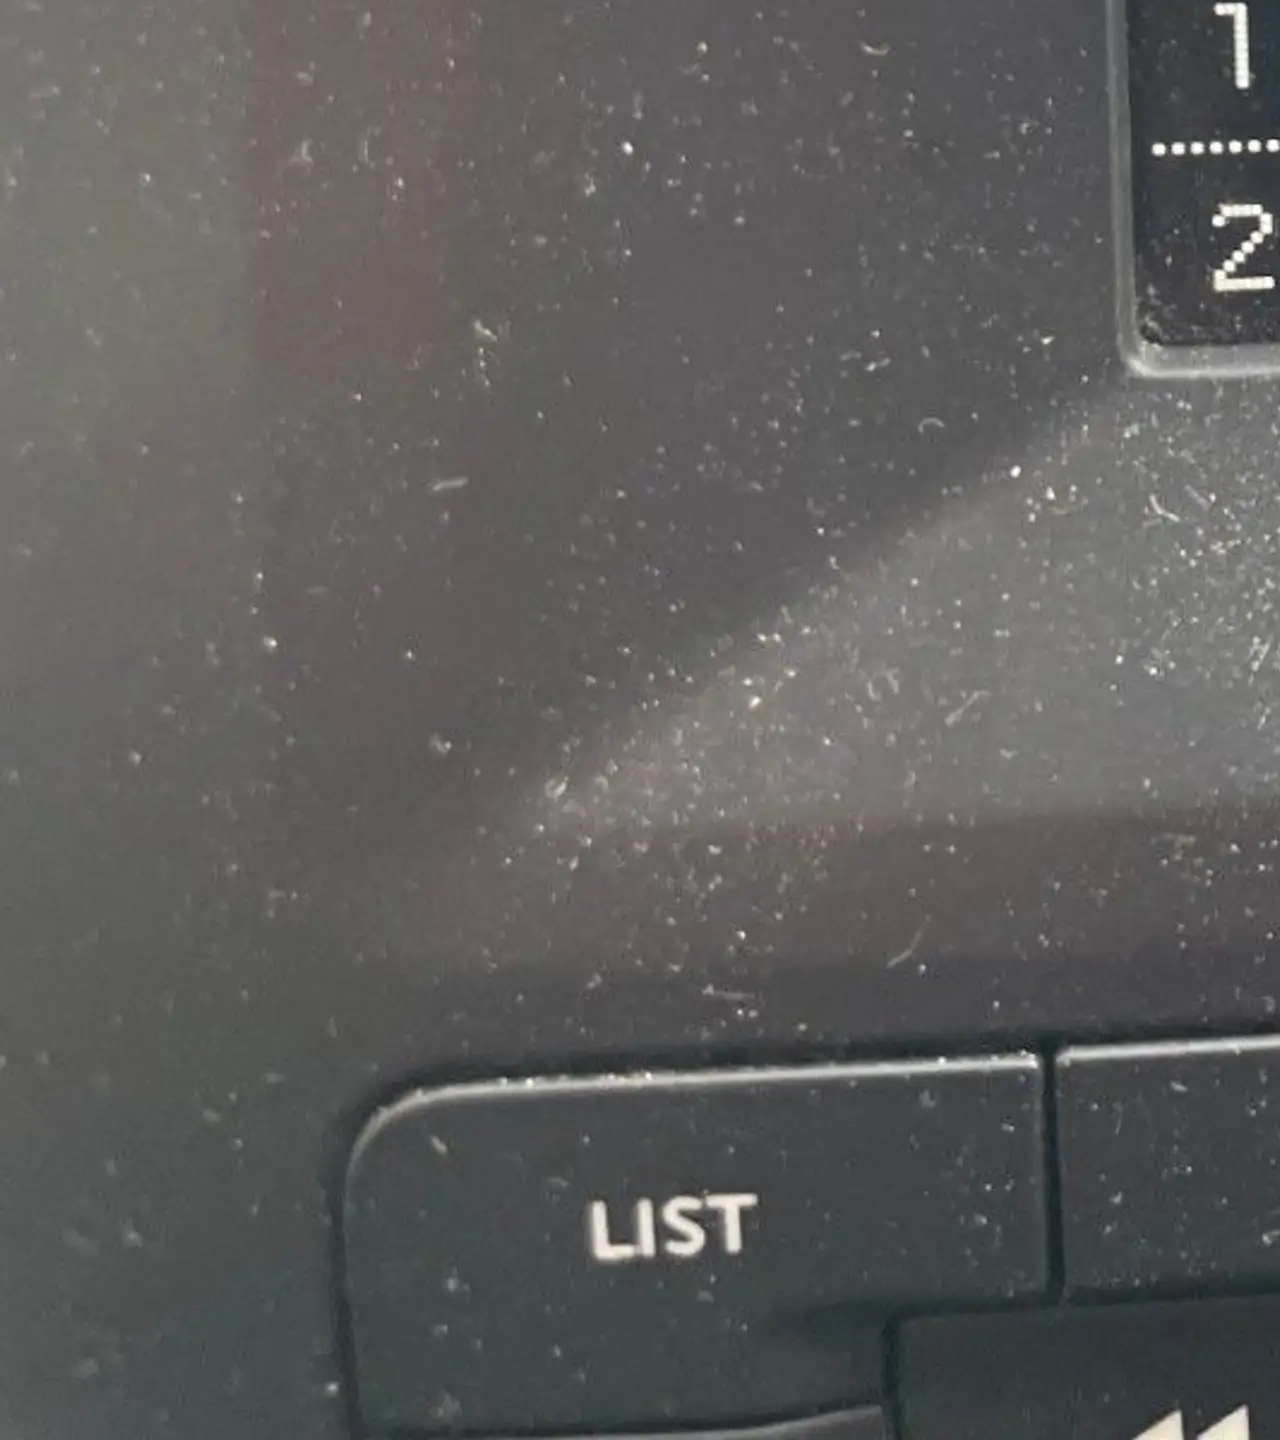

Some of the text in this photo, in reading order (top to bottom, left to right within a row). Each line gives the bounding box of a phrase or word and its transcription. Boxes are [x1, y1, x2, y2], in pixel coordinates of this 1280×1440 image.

[1213, 2, 1250, 90] 1
[1211, 203, 1275, 292] 2
[590, 1193, 758, 1261] LIST
